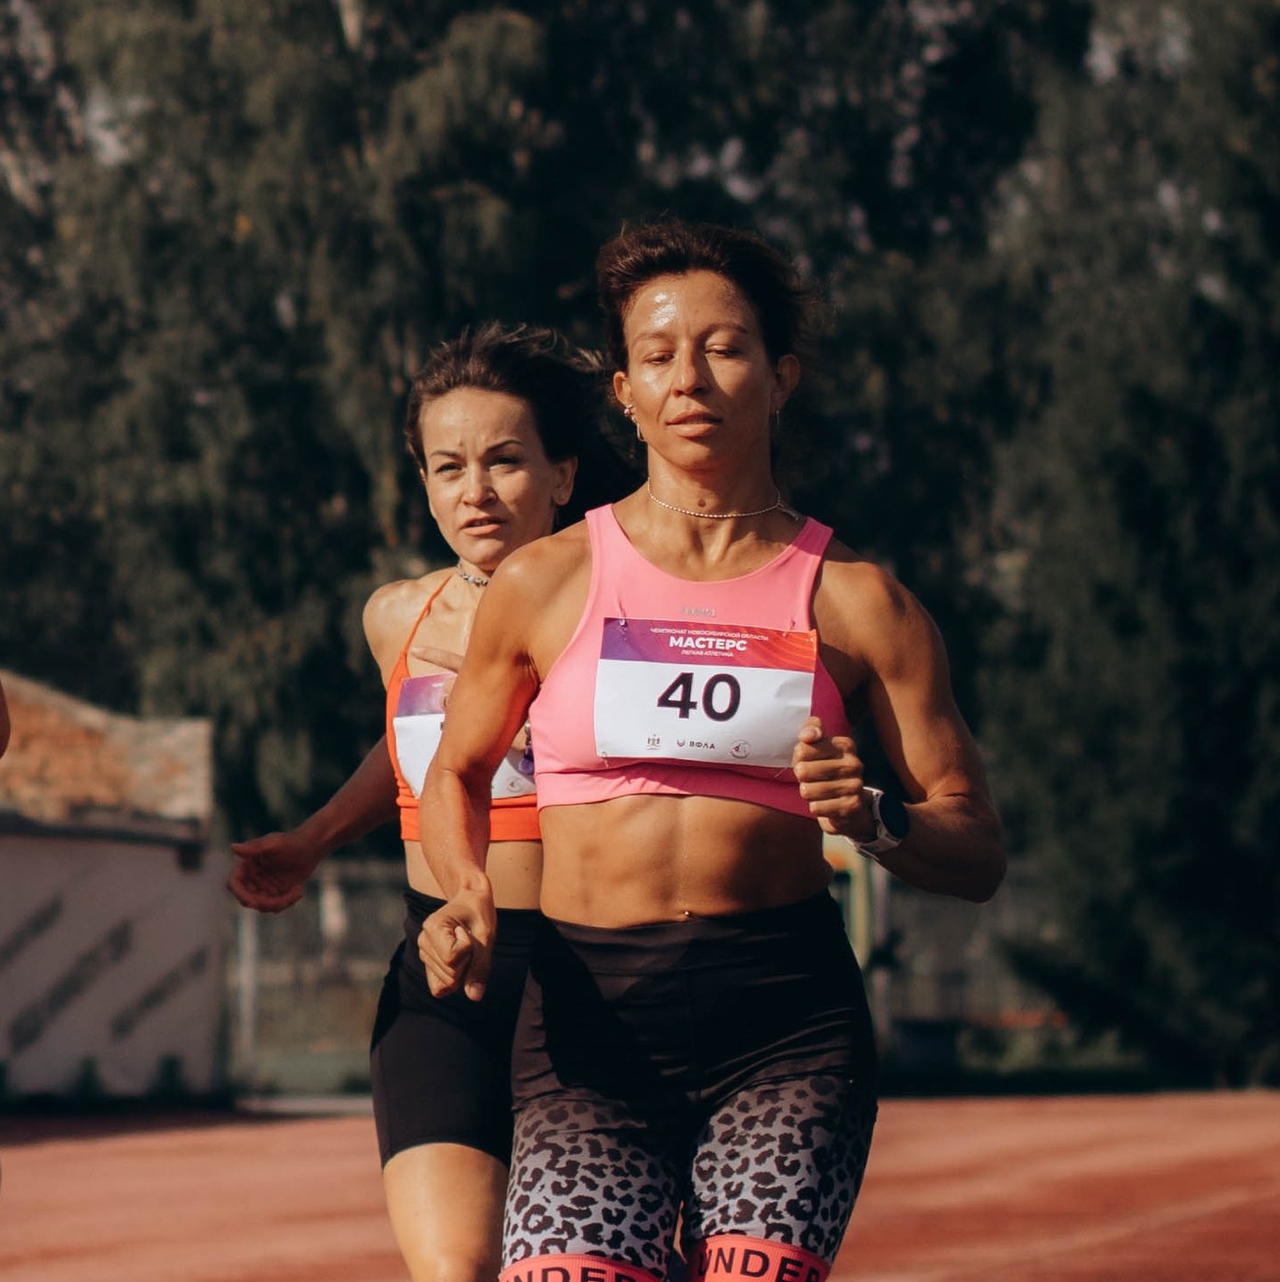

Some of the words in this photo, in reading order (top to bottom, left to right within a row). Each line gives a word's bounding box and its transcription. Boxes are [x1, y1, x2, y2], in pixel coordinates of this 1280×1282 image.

[669, 636, 747, 652] МАСТЕРС
[657, 670, 741, 722] 40
[689, 739, 716, 750] ВФЛА
